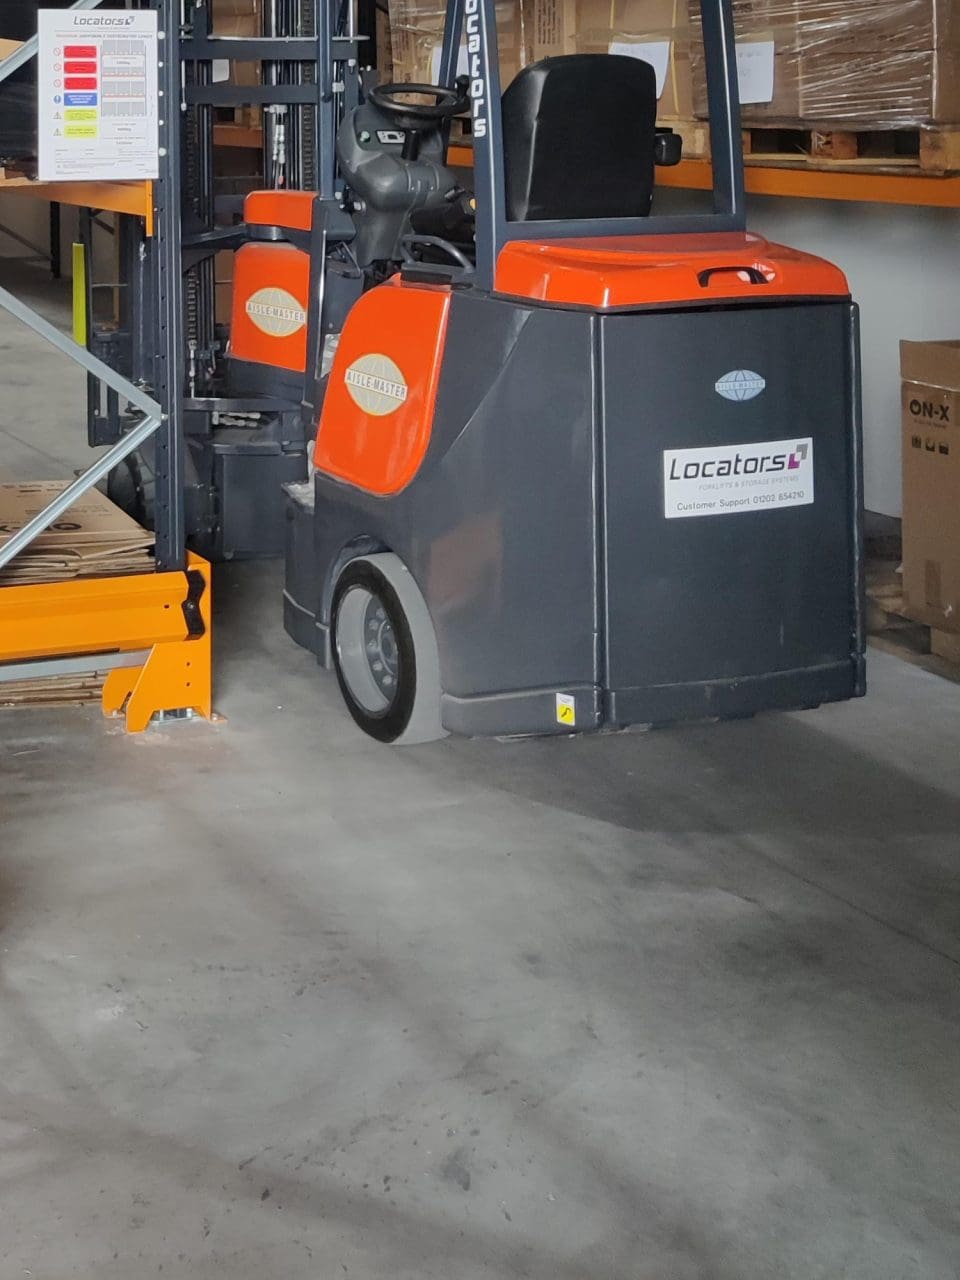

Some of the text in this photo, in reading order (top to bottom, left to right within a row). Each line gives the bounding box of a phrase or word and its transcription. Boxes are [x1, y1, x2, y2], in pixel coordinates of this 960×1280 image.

[73, 16, 125, 26] Locators
[247, 302, 305, 321] AISLE-MASTER
[346, 371, 406, 397] AISLE-MASTER
[909, 399, 950, 422] ON-X
[669, 453, 787, 481] Locators
[676, 500, 717, 511] Customer
[719, 496, 750, 508] Support
[752, 493, 776, 504] 01202
